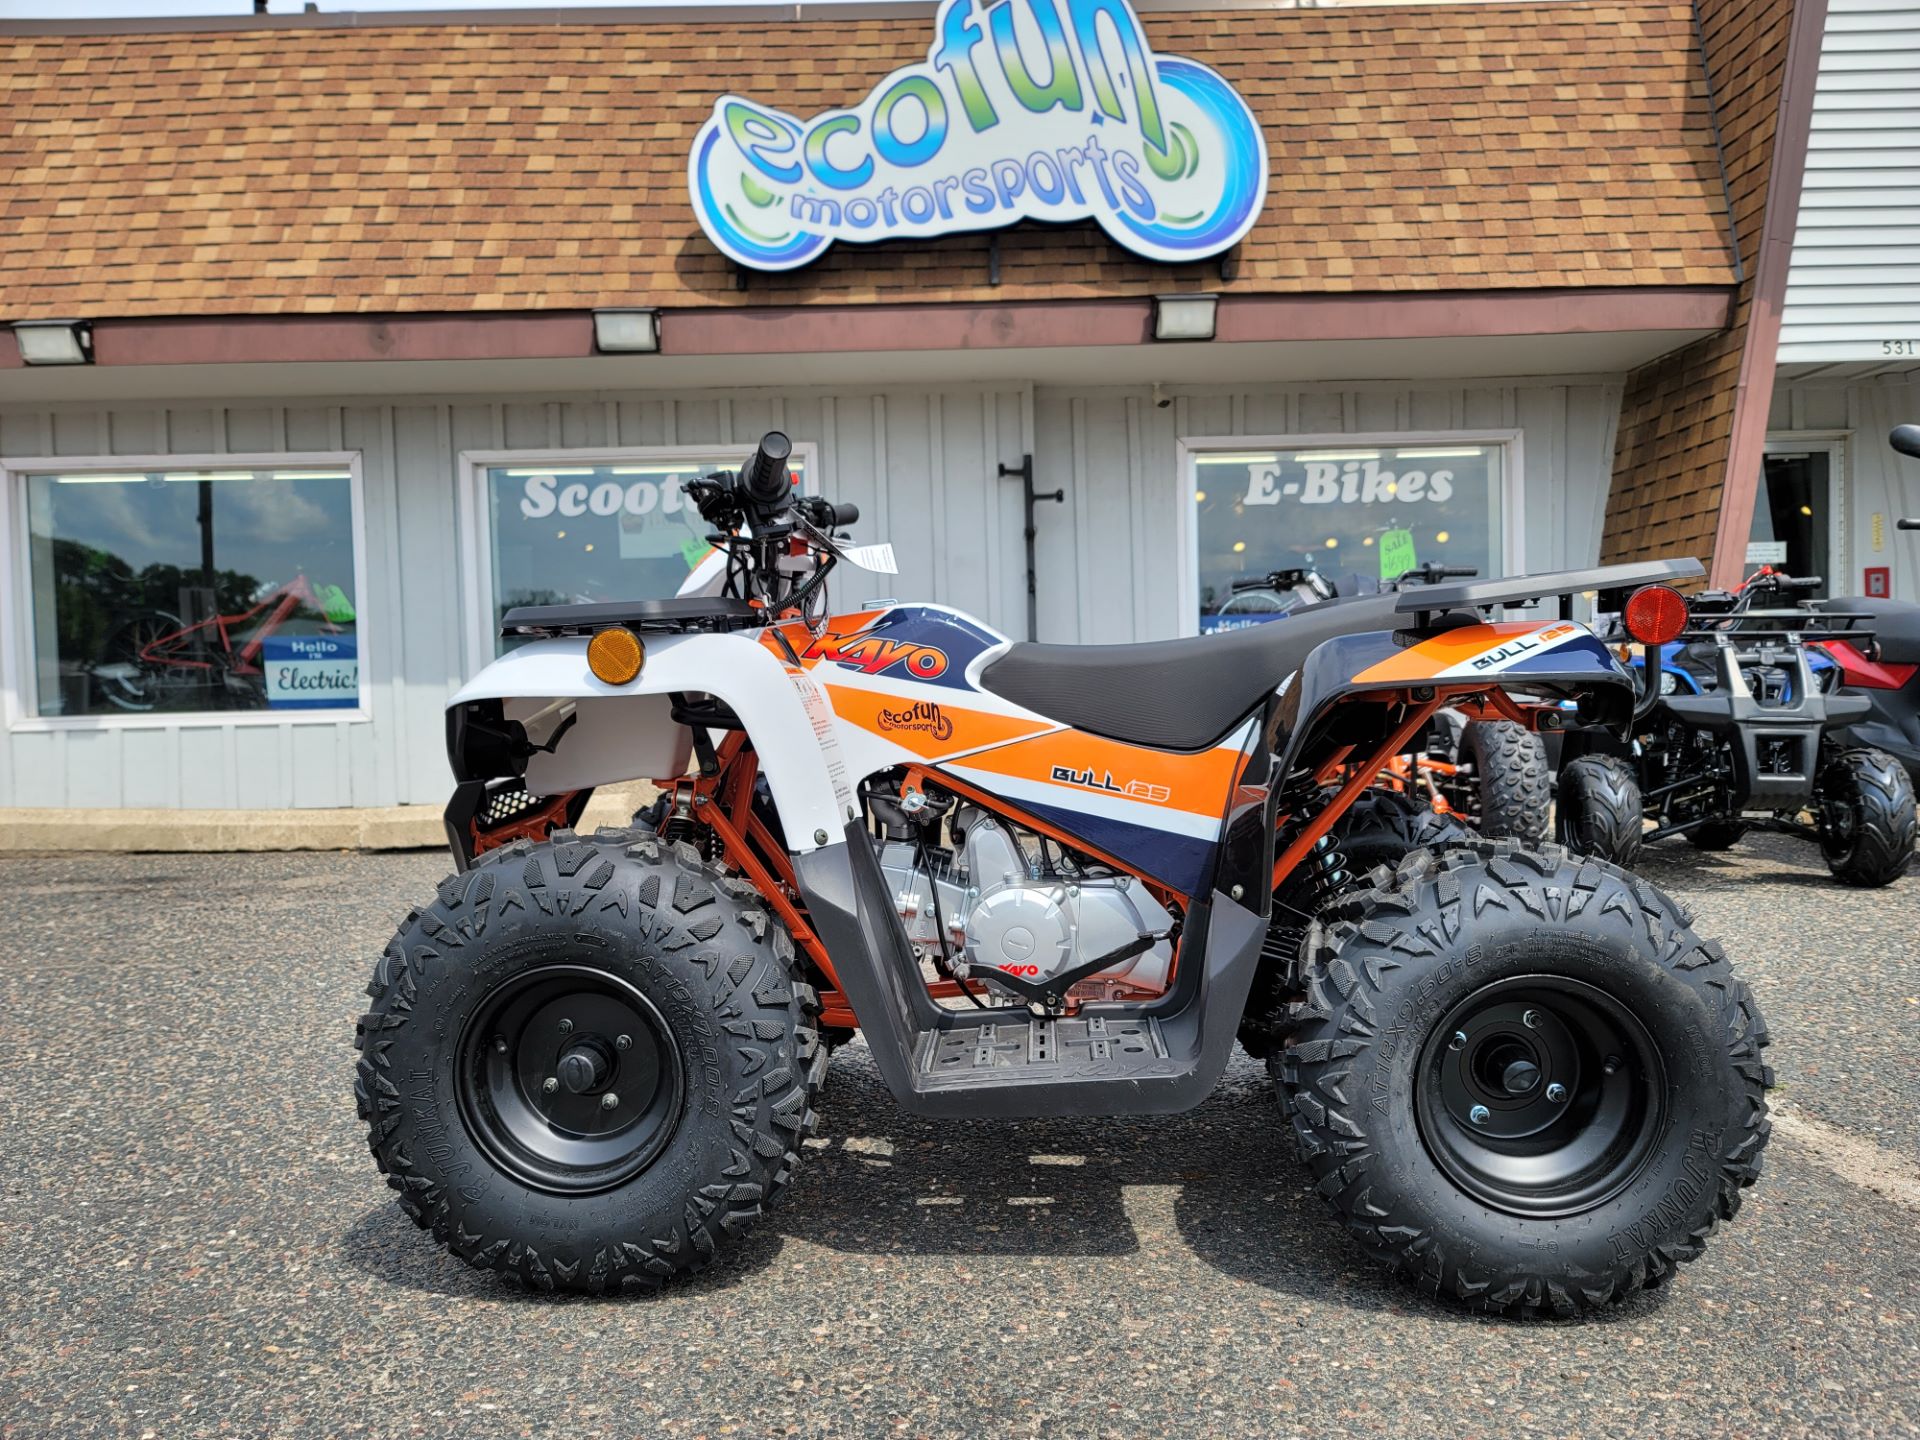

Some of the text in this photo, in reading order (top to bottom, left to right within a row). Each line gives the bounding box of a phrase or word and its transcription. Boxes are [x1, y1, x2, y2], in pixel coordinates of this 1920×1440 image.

[725, 0, 1168, 190] ecofun
[790, 135, 1157, 229] motorsports
[1882, 340, 1914, 355] 531
[1243, 460, 1454, 506] E-Bikes
[291, 640, 339, 653] Hello
[803, 622, 950, 680] KAYO
[1471, 624, 1576, 670] BULL 125
[277, 667, 359, 691] Electric!
[882, 701, 942, 731] ecofun
[888, 721, 938, 736] motorsports
[1051, 764, 1171, 803] BULL 125
[408, 1067, 473, 1178] JUNKAI
[1606, 1154, 1709, 1261] JUNKAI
